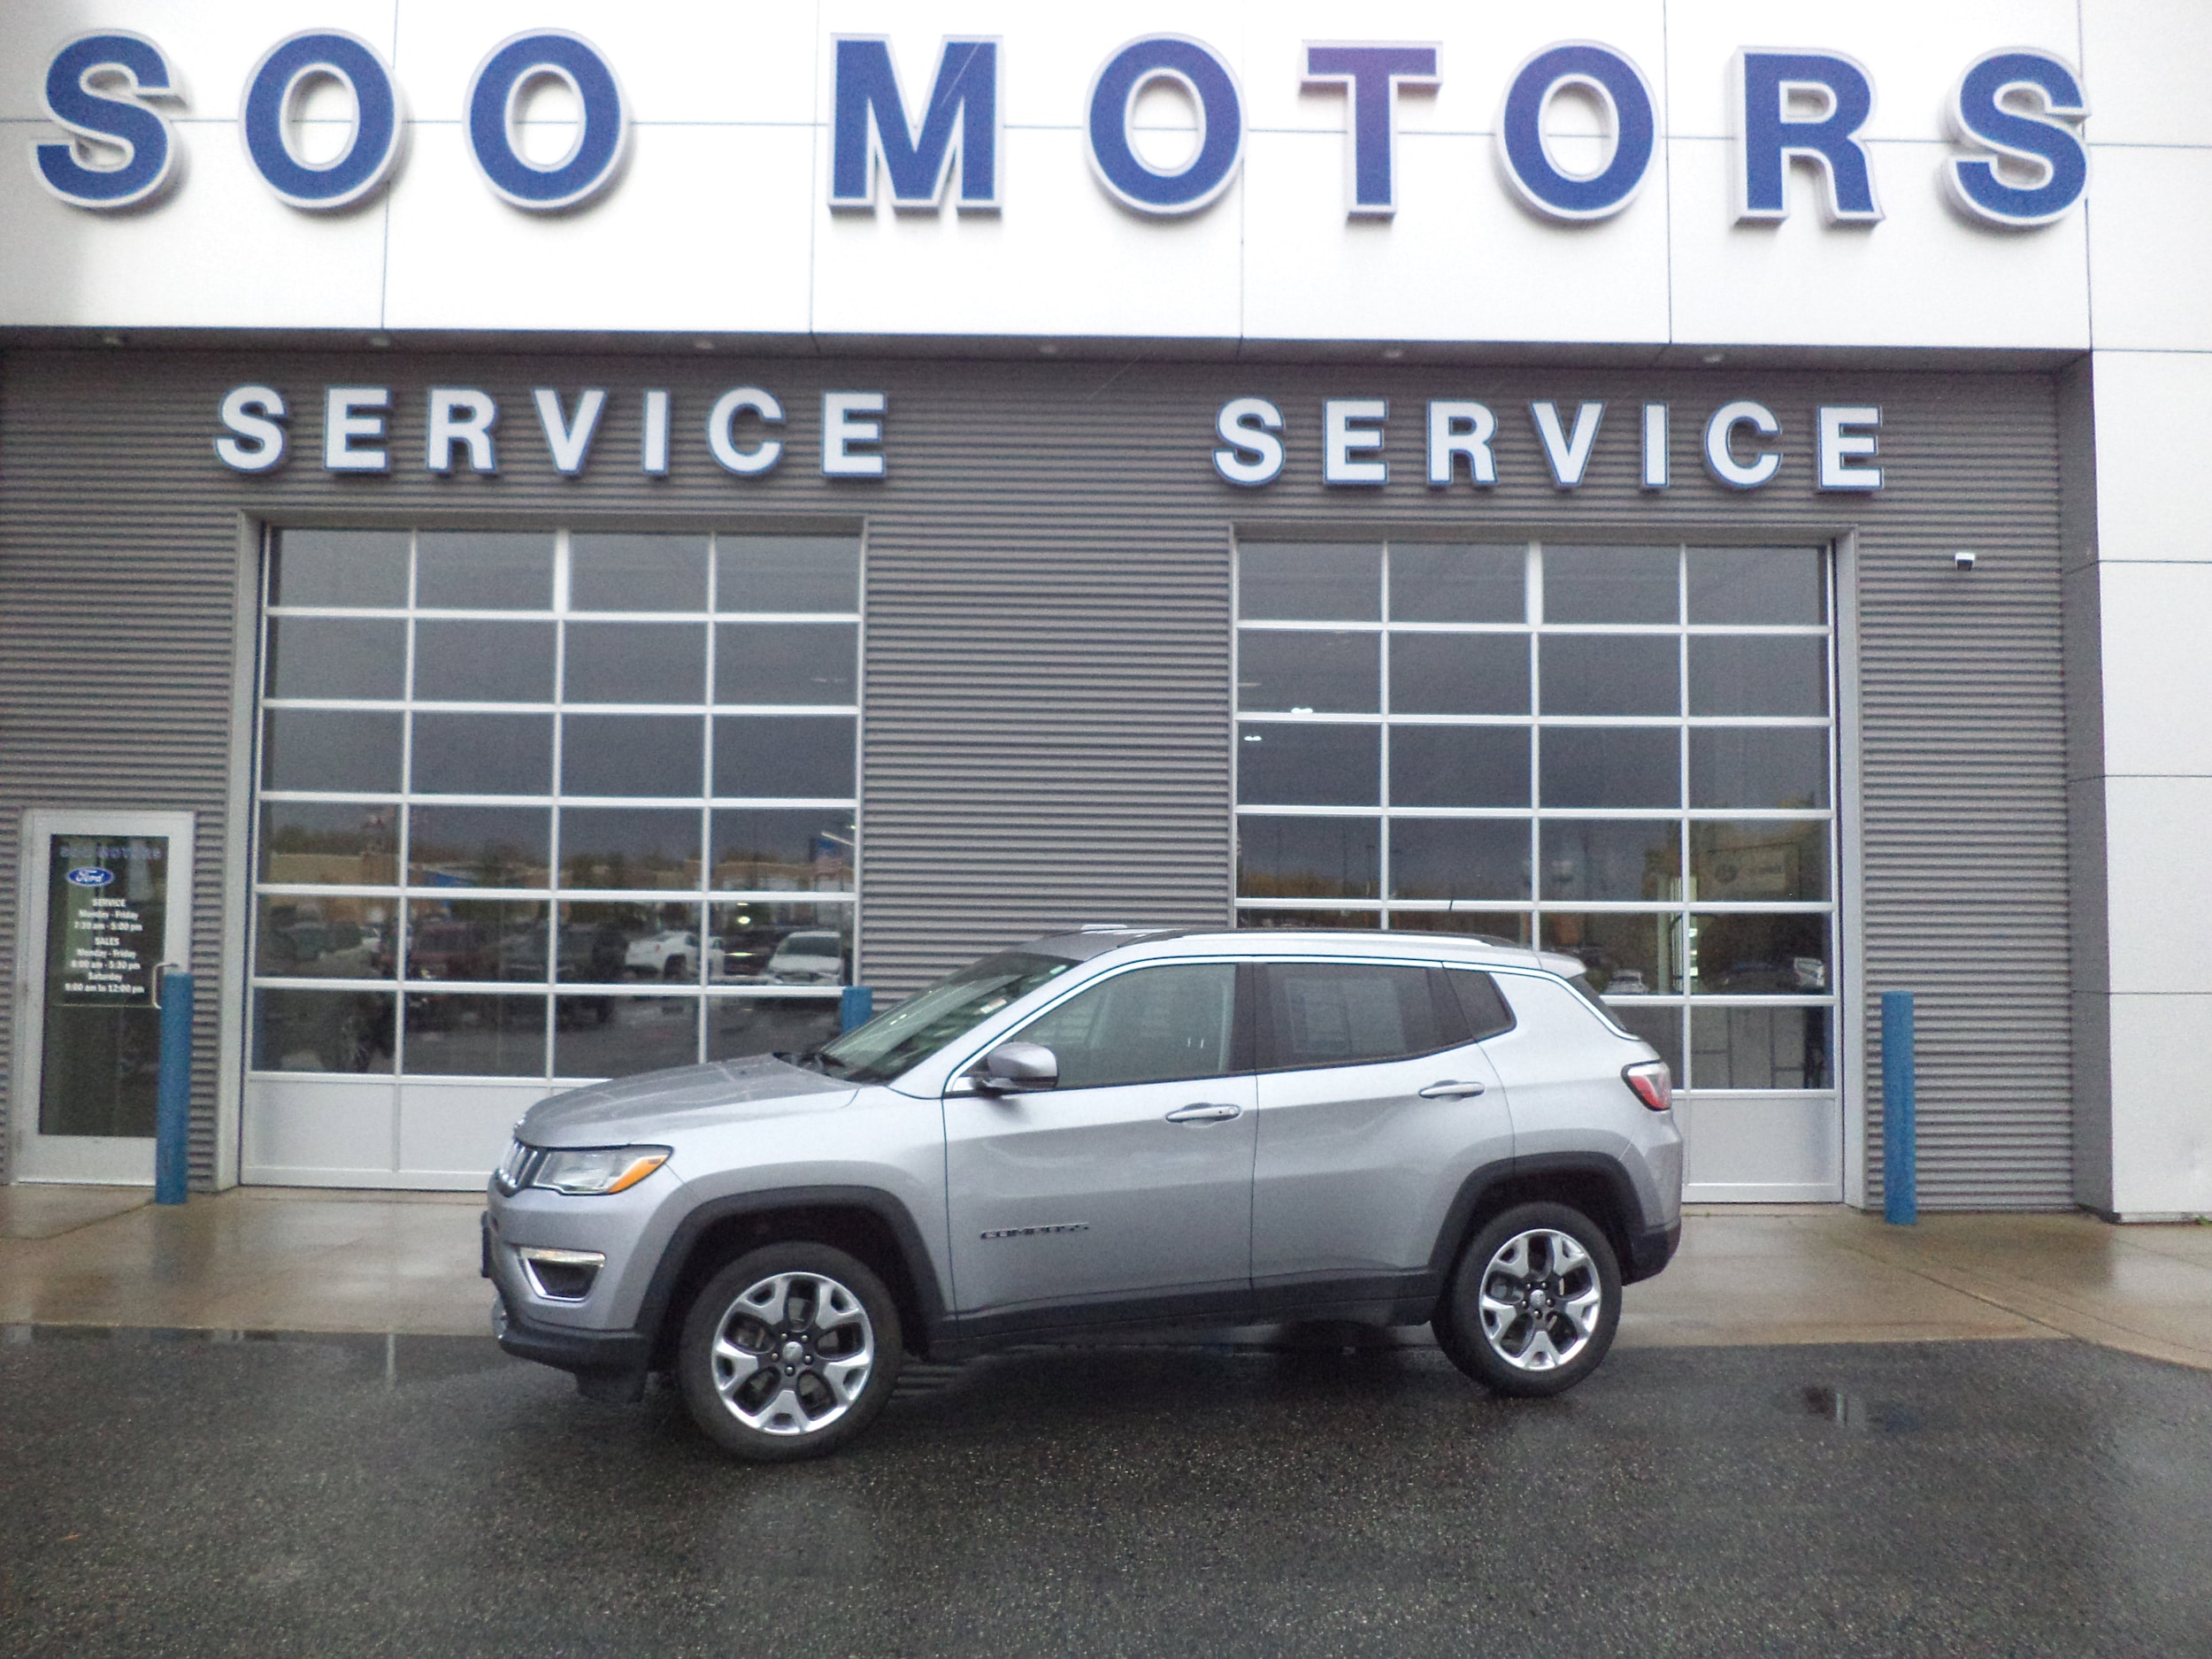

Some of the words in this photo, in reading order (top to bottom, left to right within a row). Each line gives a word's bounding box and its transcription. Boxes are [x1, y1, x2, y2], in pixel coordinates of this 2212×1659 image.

[28, 27, 626, 212] SOO
[826, 32, 2090, 230] MOTORS
[213, 383, 887, 481] SERVICE
[1211, 396, 1885, 494] SERVICE
[92, 898, 127, 908] SERVICE
[79, 910, 110, 919] Monday
[115, 910, 140, 920] Friday
[94, 937, 120, 947] SALES
[77, 949, 107, 958] Monday
[112, 949, 137, 960] Friday
[88, 972, 123, 982] Saturday
